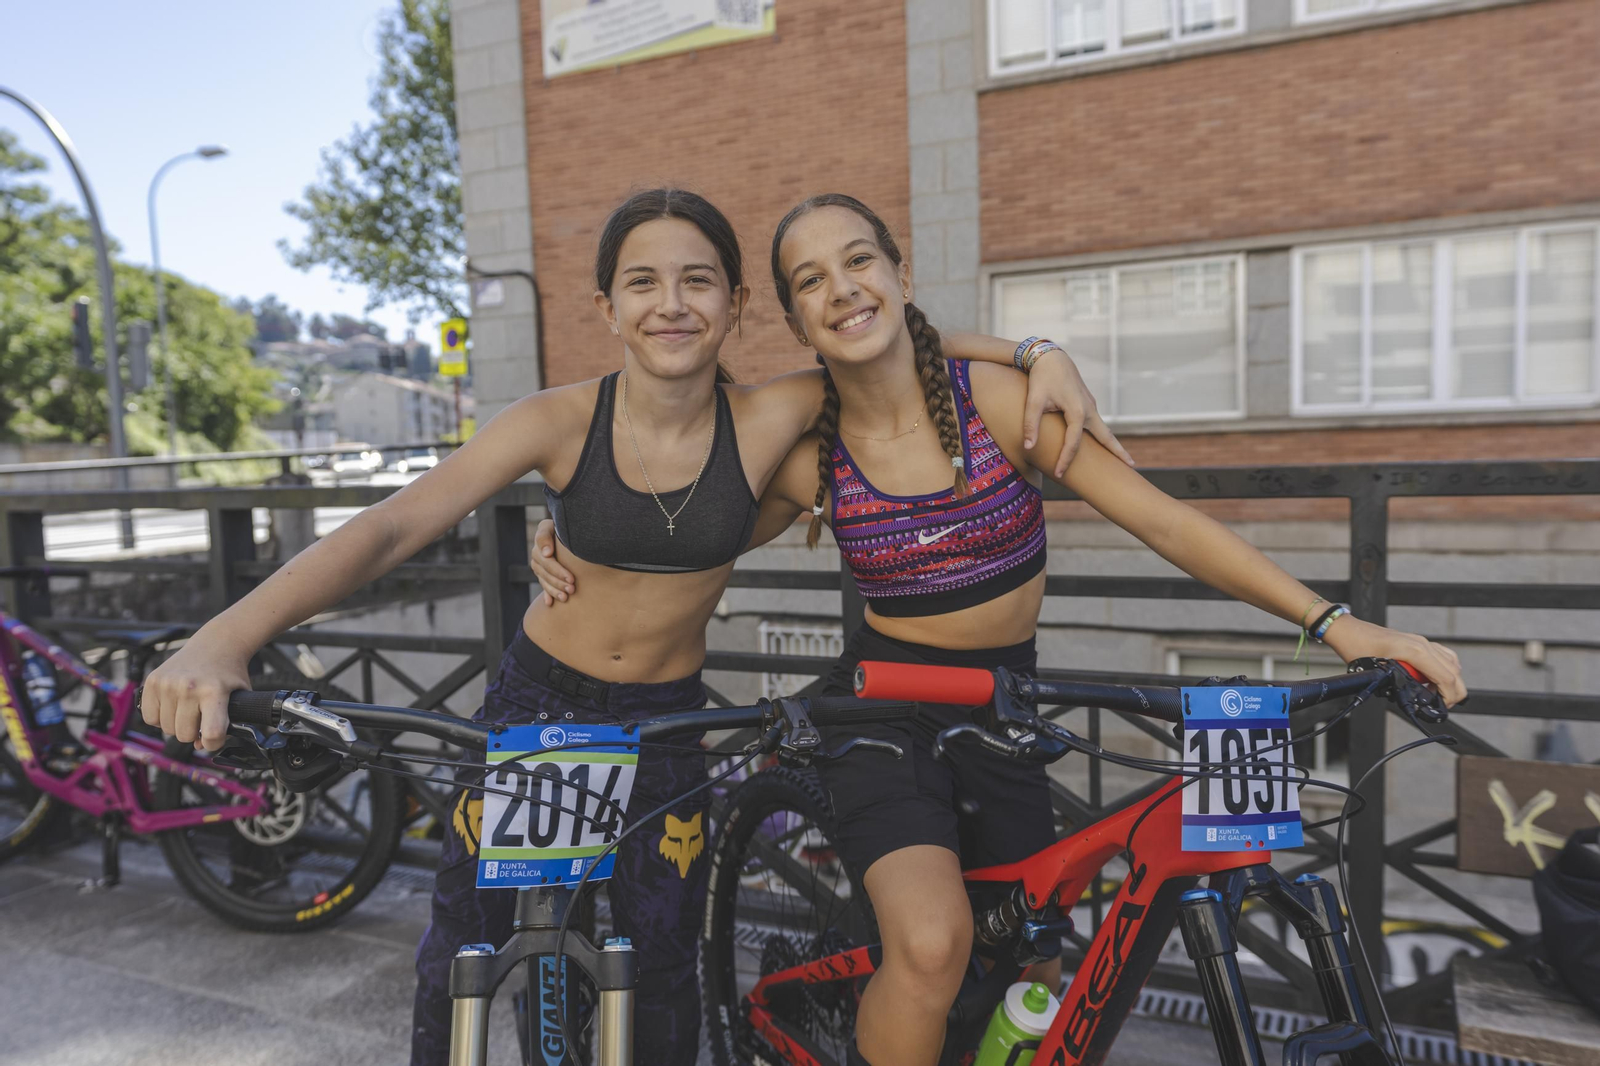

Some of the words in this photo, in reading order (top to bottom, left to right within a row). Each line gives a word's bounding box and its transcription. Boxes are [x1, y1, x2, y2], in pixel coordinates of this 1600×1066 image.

[490, 762, 623, 848] 2014
[1189, 728, 1289, 816] 1057
[499, 870, 510, 878] DE
[511, 870, 542, 878] GALICIA
[500, 862, 527, 870] XUNTA
[542, 962, 565, 1058] GIANT
